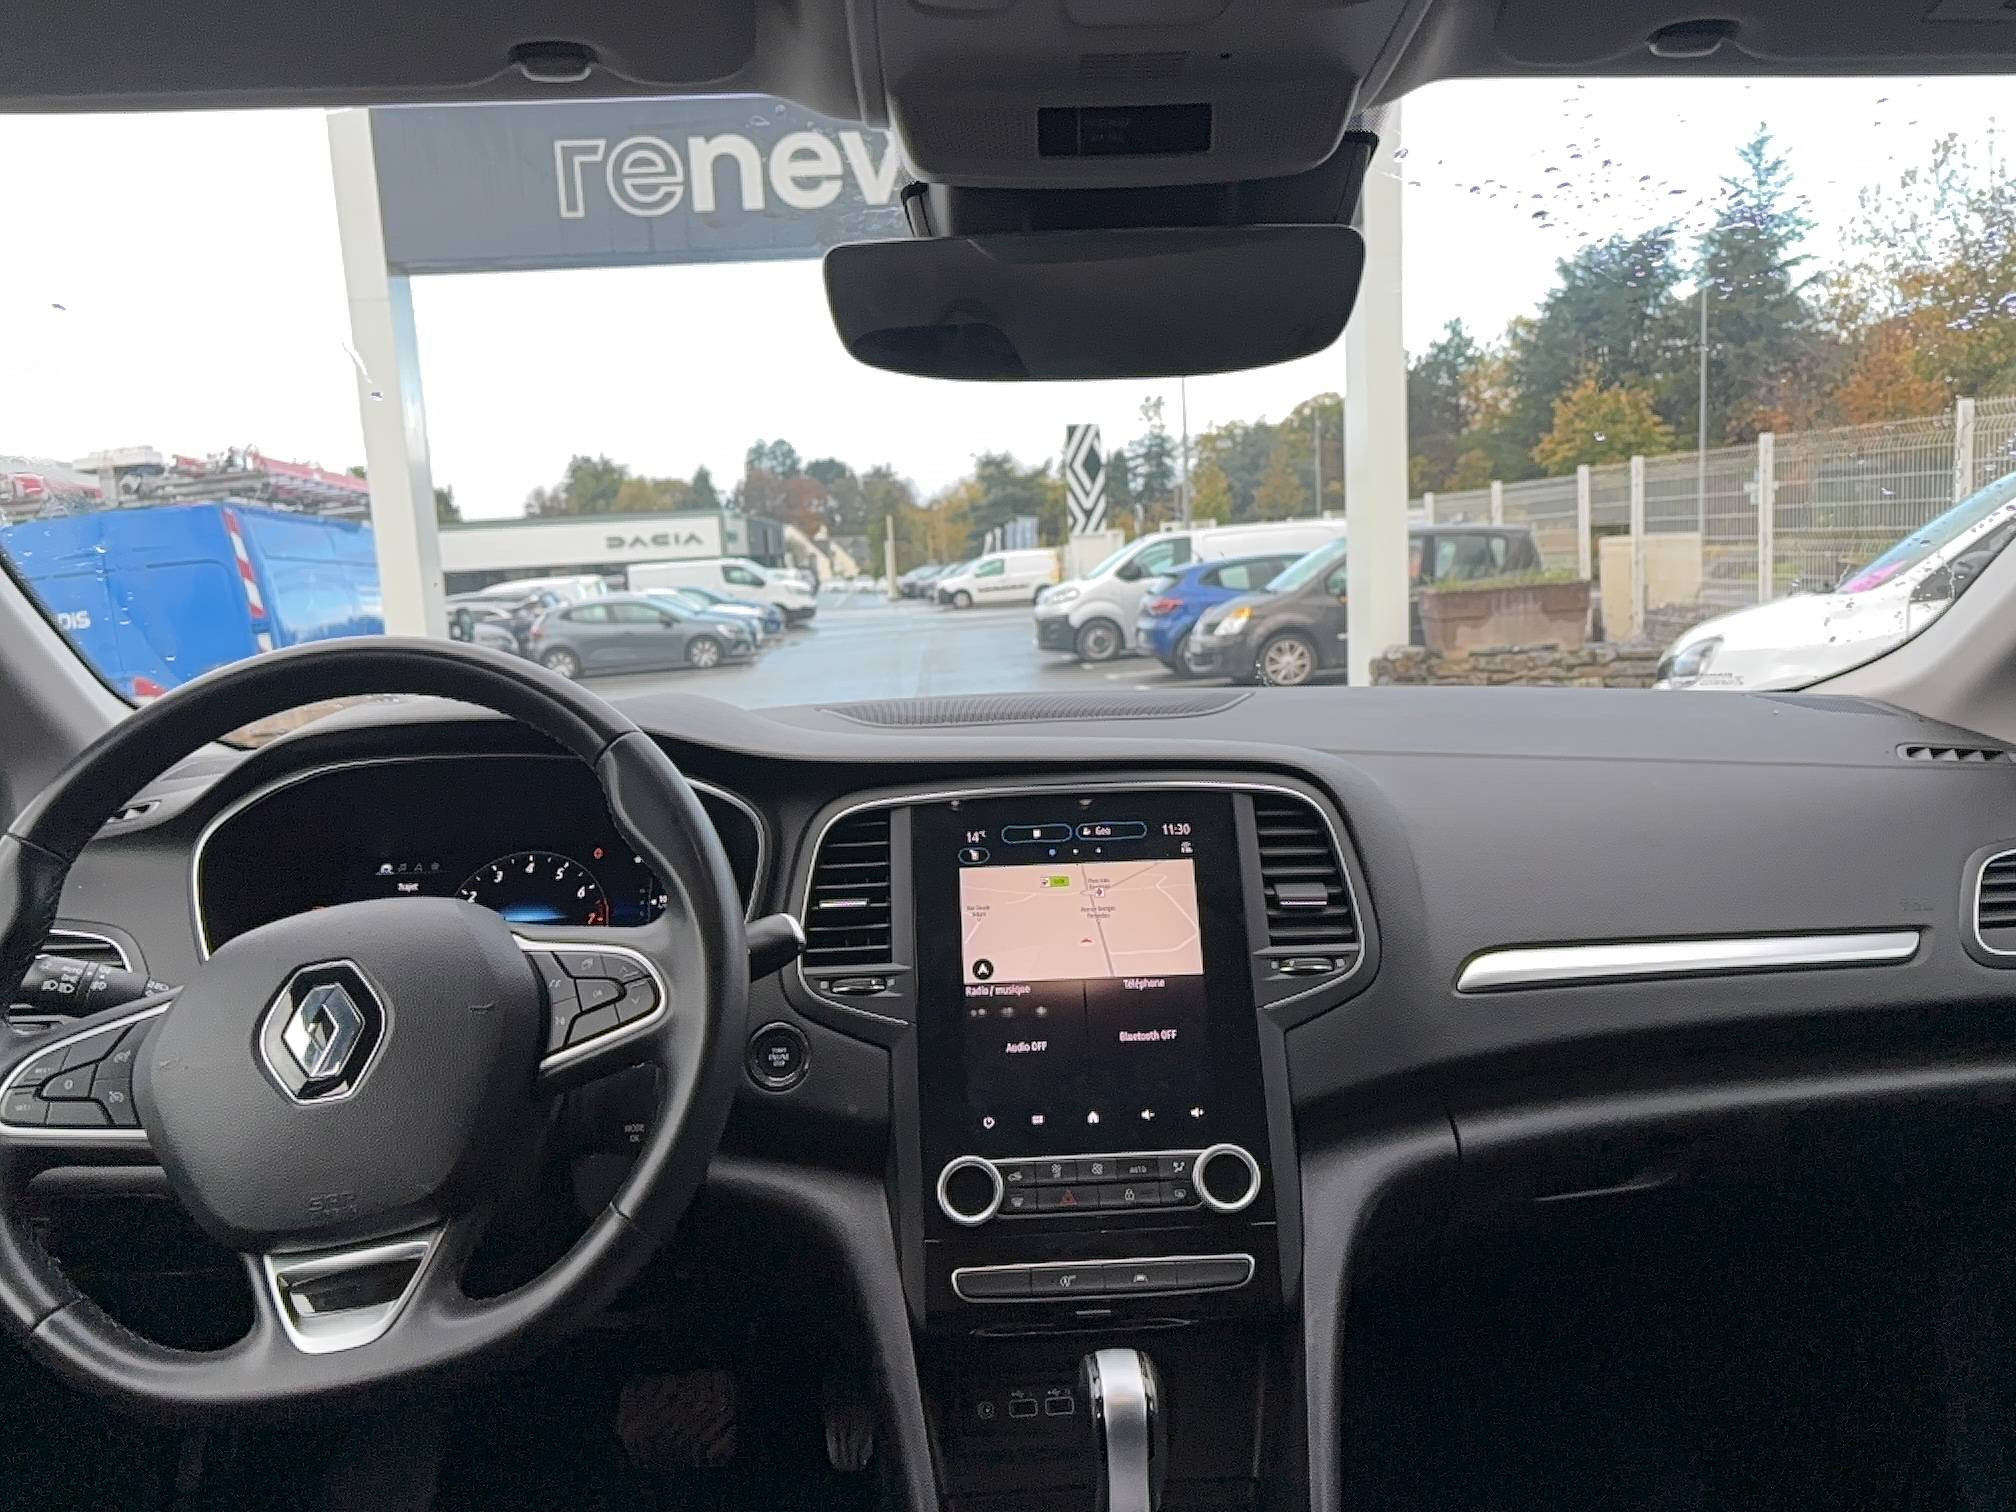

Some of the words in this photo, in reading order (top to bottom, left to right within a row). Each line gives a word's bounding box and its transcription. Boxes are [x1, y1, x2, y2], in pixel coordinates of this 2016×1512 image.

[606, 531, 704, 549] DACIA
[1162, 823, 1191, 836] 11:30
[525, 862, 535, 874] 4
[555, 867, 565, 880] 5
[493, 870, 504, 883] 3
[467, 891, 478, 903] 2
[576, 886, 586, 898] 6
[587, 912, 597, 925] 7
[965, 985, 989, 997] Radio
[995, 984, 1031, 997] musique
[1123, 978, 1166, 991] Téléphone
[1119, 1030, 1160, 1042] Bluetooth
[1161, 1029, 1177, 1040] OFF
[1005, 1042, 1030, 1053] Audio
[1031, 1041, 1048, 1051] OFF
